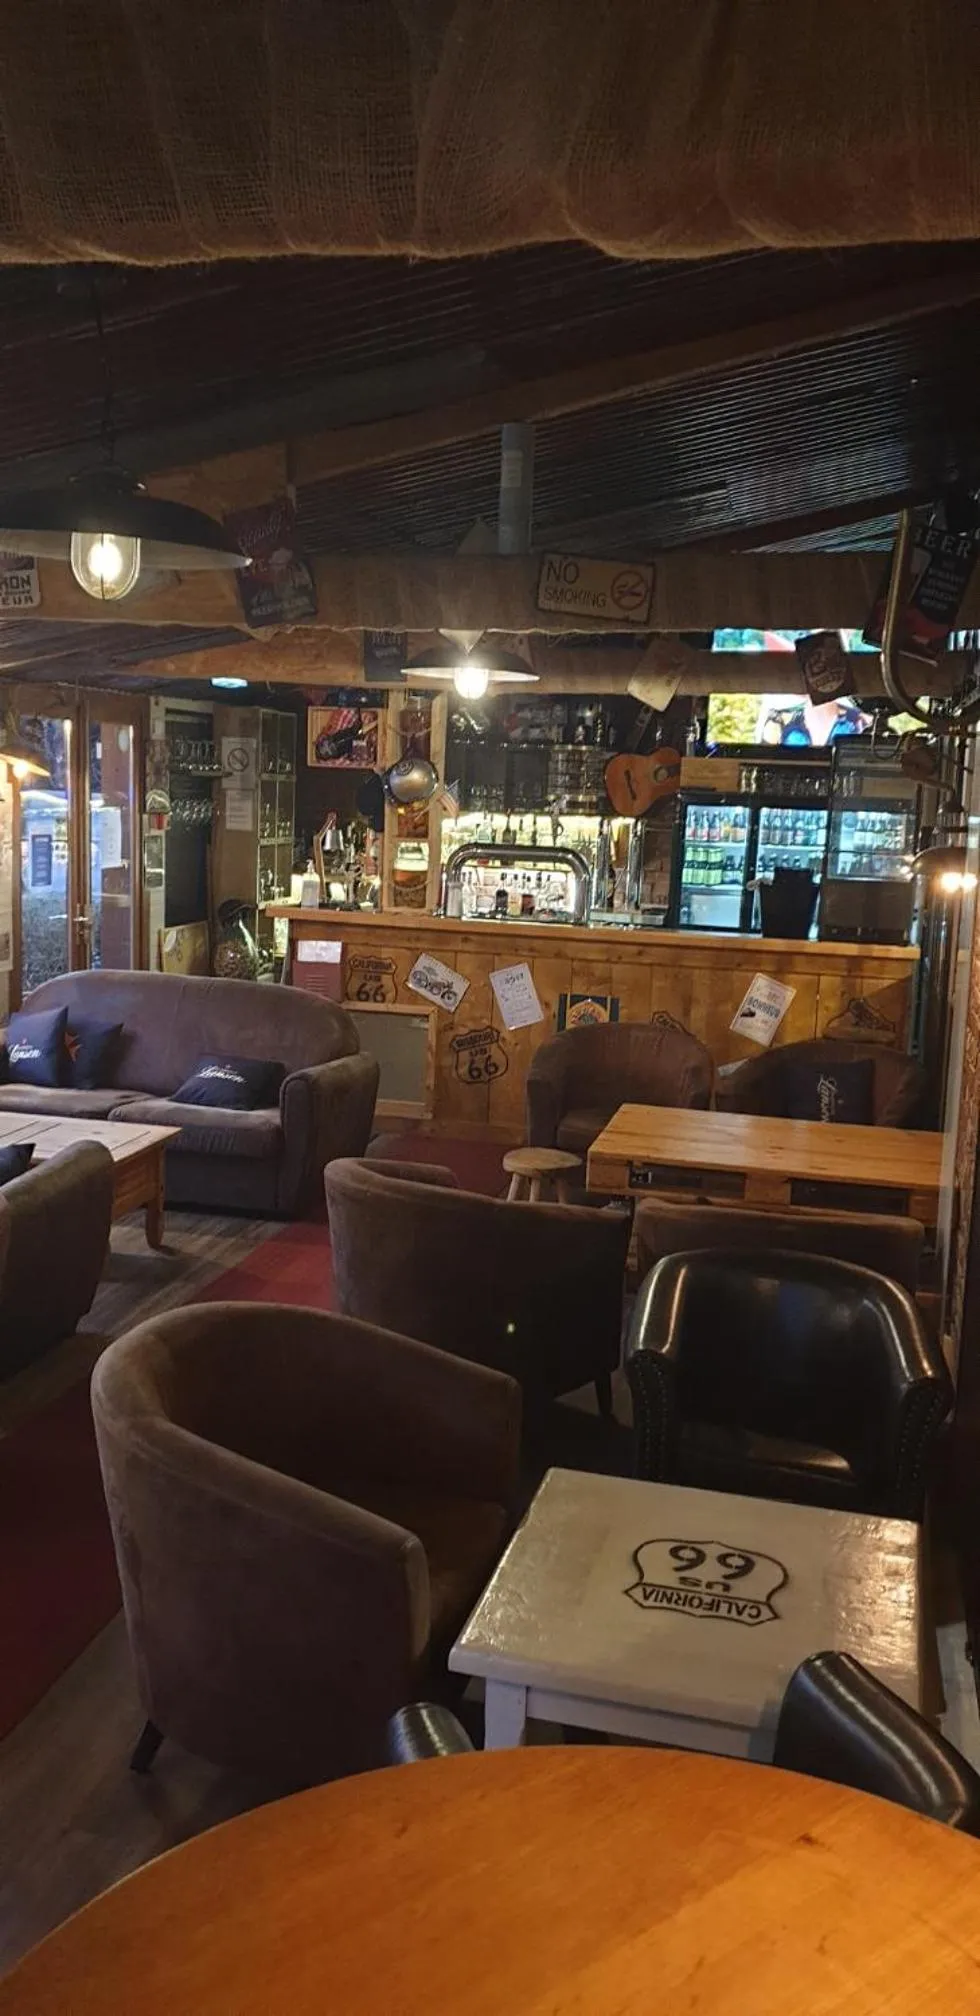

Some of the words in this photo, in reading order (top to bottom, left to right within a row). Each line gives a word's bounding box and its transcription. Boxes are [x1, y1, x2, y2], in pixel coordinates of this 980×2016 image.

[546, 560, 580, 586] NO
[544, 585, 607, 609] SMOKING
[356, 982, 386, 1002] 66
[468, 1055, 499, 1080] 66
[669, 1545, 755, 1580] 66
[678, 1576, 732, 1593] US
[642, 1587, 762, 1619] CALIFORNIA
